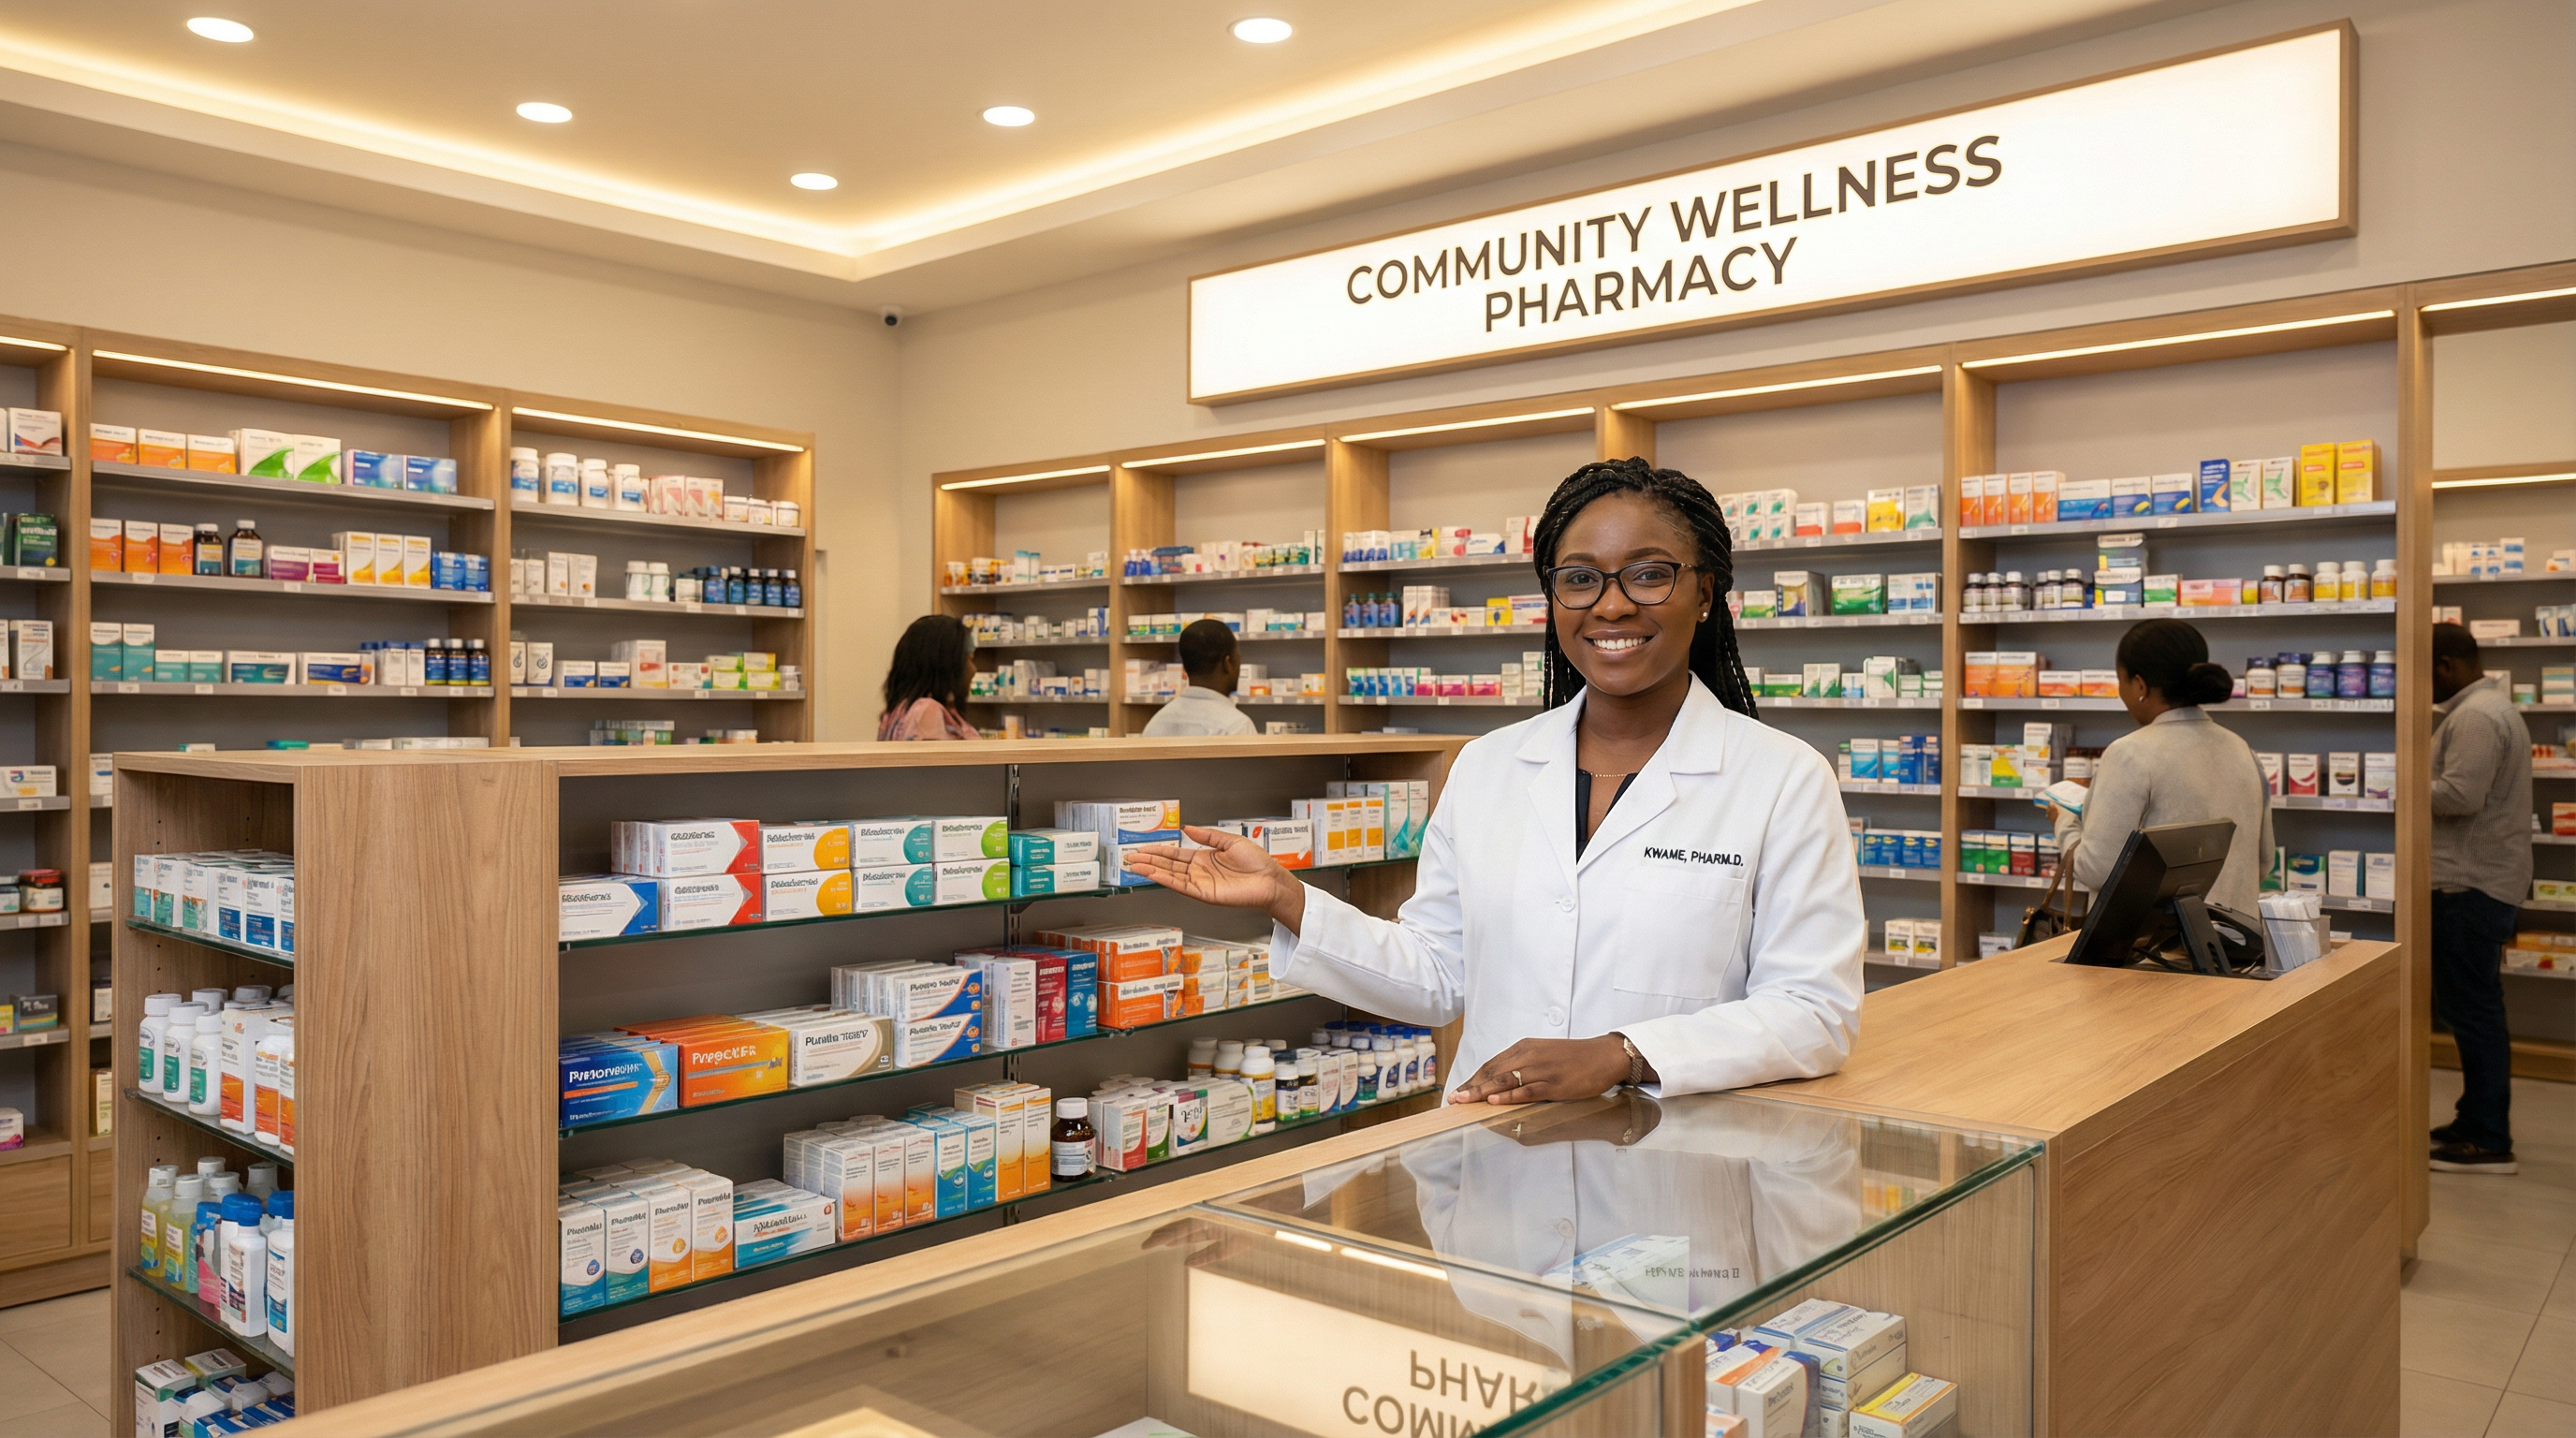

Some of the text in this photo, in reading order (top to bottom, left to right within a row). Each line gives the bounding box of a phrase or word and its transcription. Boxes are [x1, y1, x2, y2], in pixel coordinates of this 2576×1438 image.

[1347, 135, 2002, 305] COMMUNITY WELLNESS
[1486, 236, 1798, 332] PHARMACY
[1644, 846, 1744, 867] KWAME, PHARM.D.
